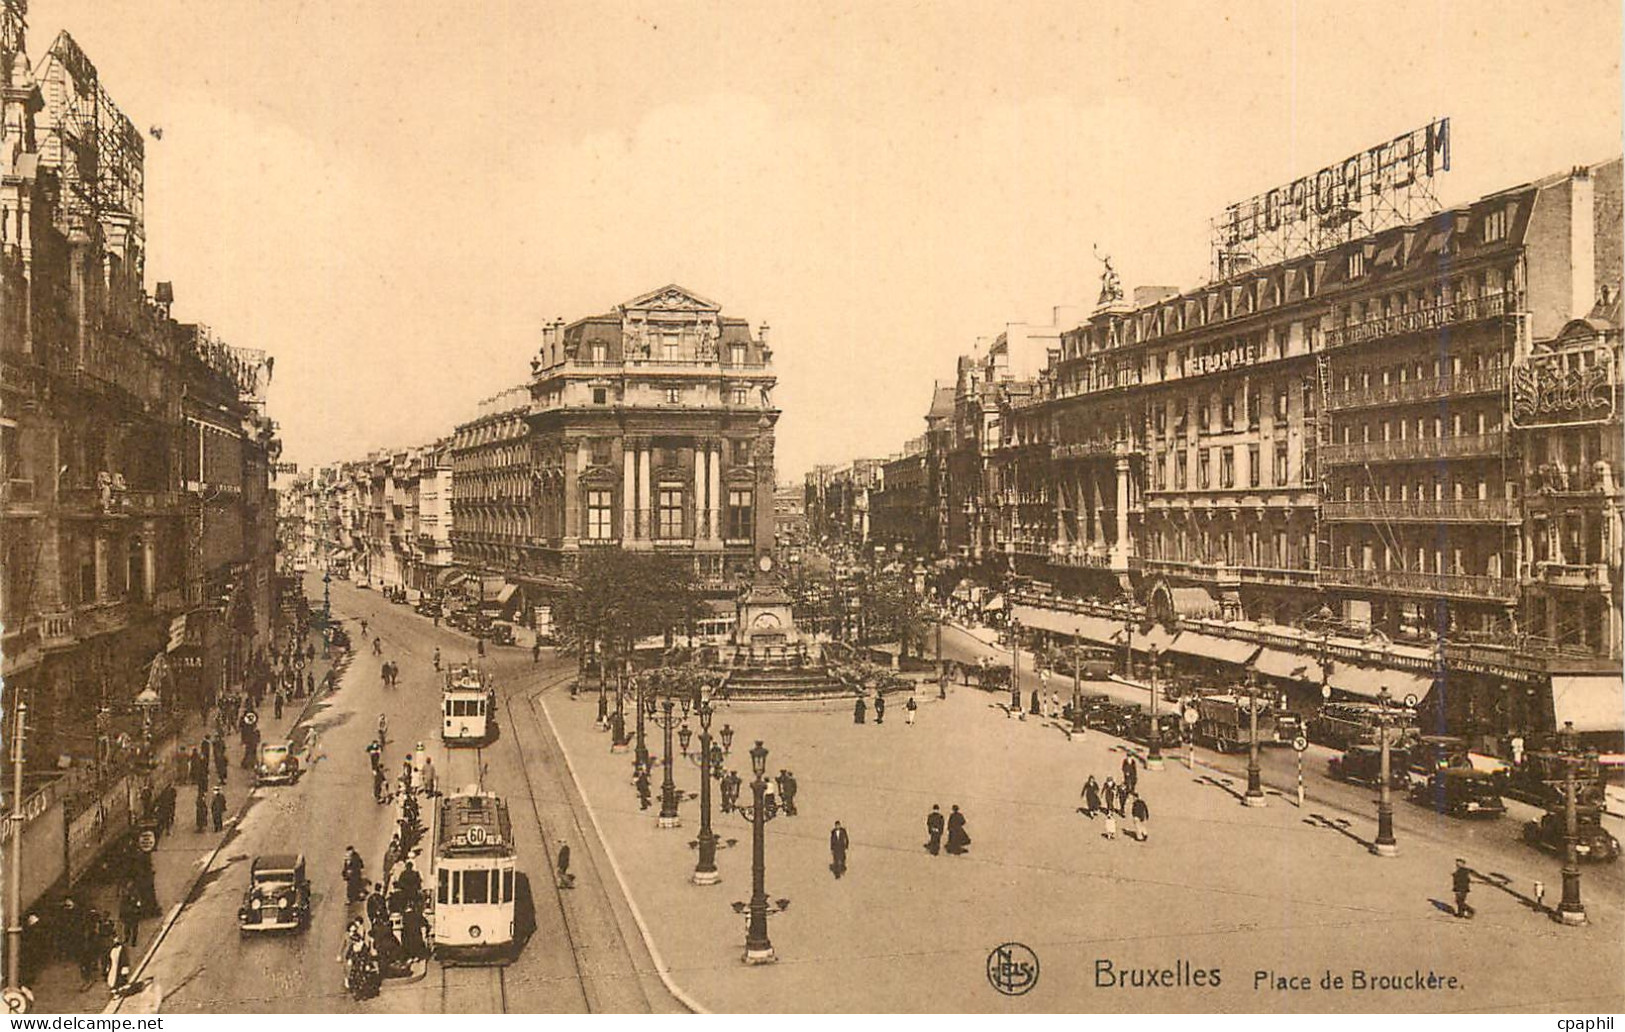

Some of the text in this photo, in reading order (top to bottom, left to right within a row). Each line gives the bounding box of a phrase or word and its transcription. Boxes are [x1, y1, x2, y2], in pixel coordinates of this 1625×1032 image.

[1184, 345, 1254, 378] METROPOLE
[939, 457, 948, 550] ATLANTA
[470, 828, 484, 842] 60
